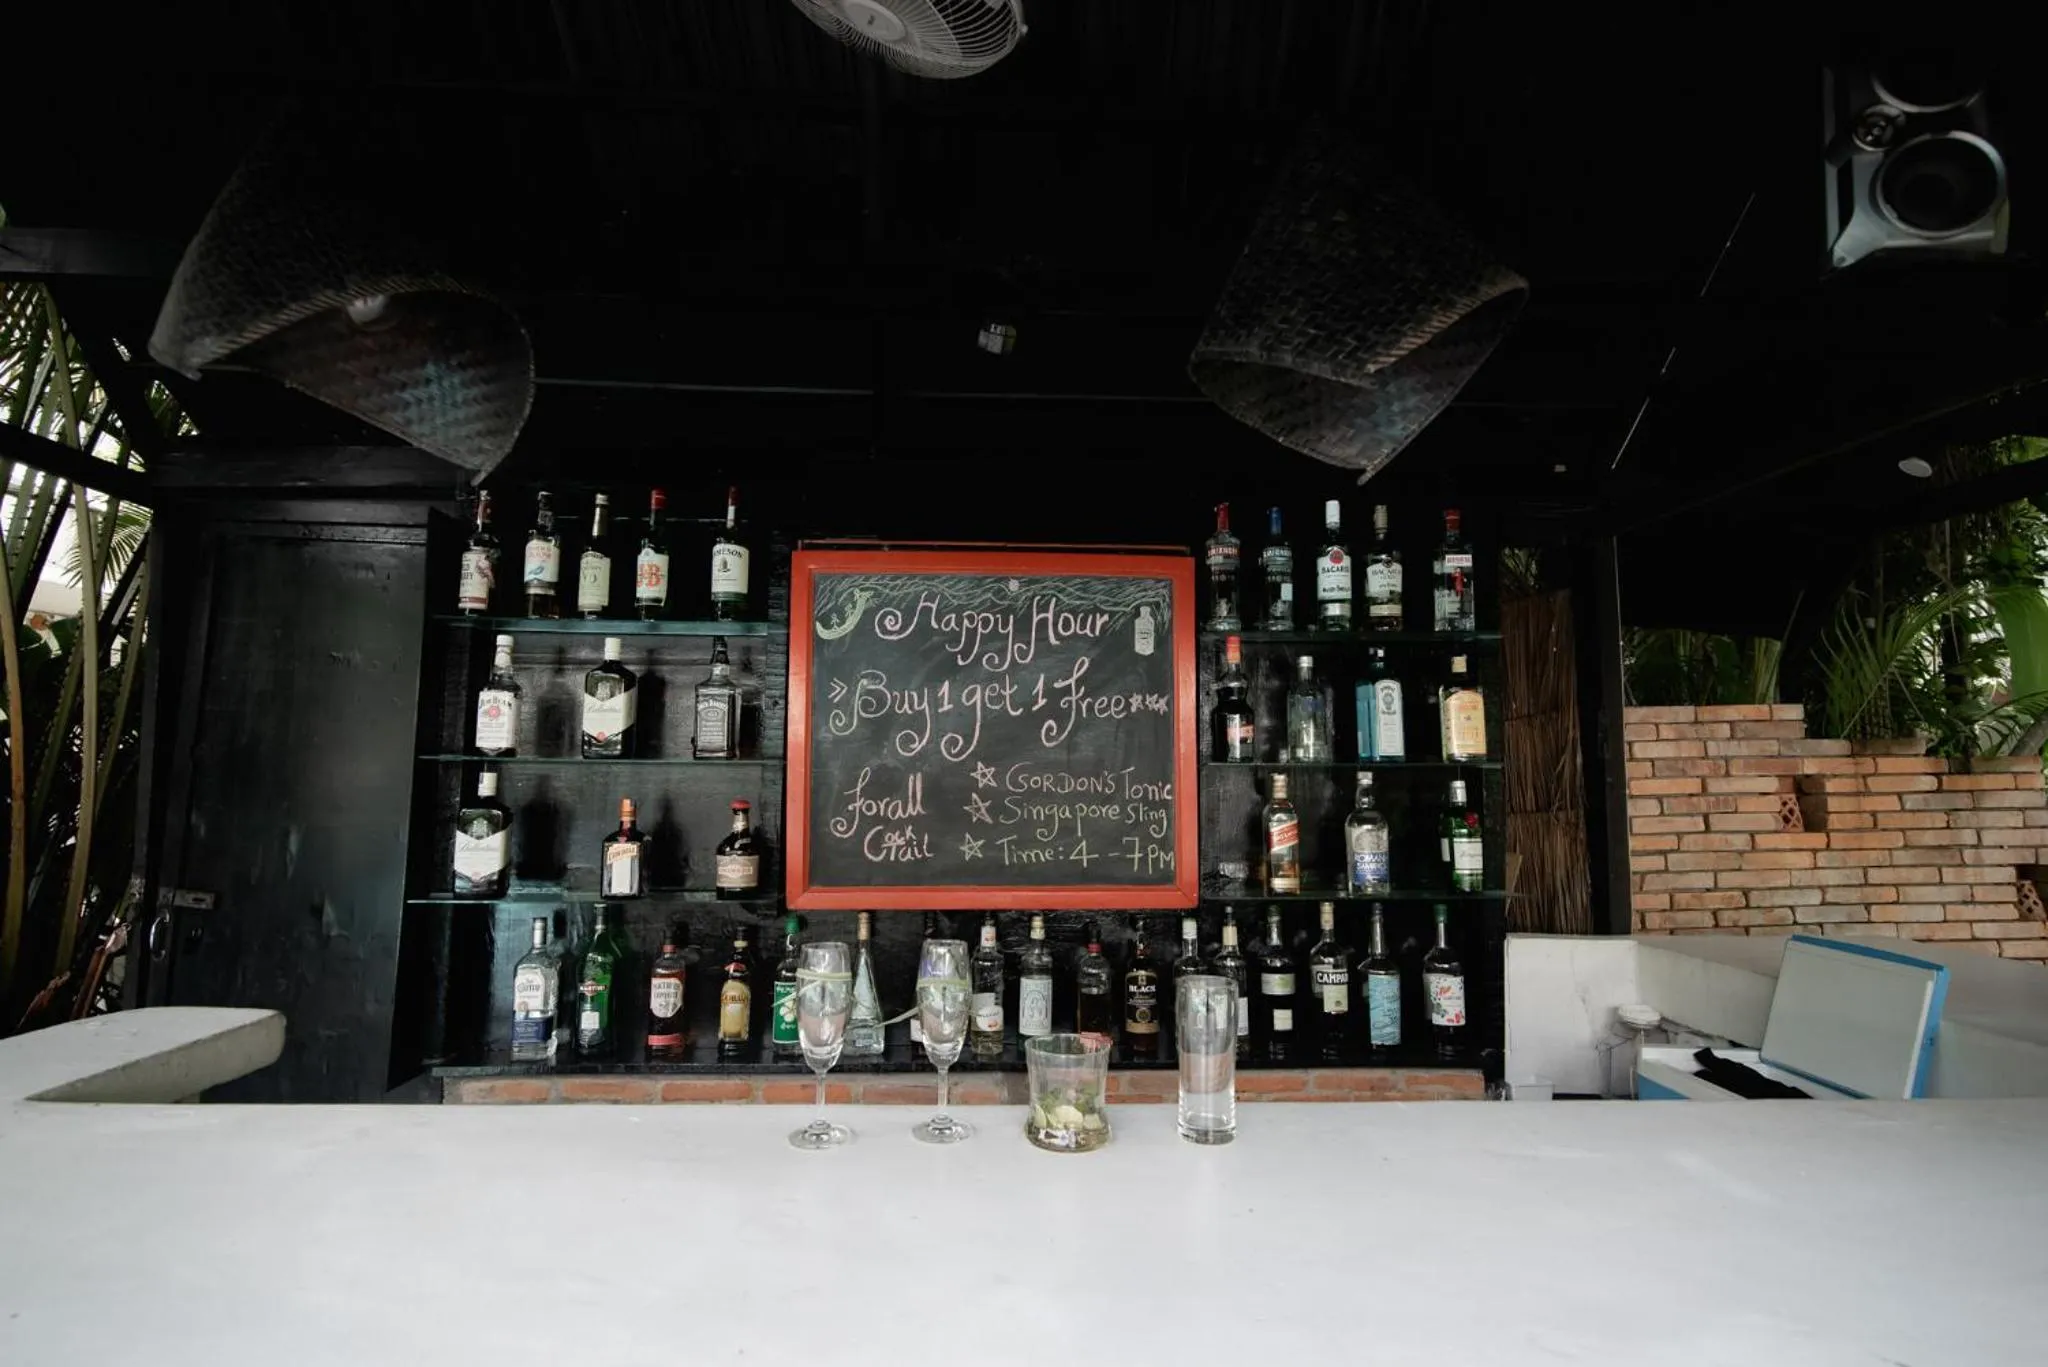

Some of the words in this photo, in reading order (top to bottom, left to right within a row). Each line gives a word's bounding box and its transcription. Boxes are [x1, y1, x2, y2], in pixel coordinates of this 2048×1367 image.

[875, 590, 1014, 671] Happy
[1014, 596, 1110, 664] Hour
[829, 669, 931, 757] Buy
[936, 679, 954, 713] 1
[1031, 673, 1046, 712] 1
[939, 673, 1023, 762] get
[1005, 762, 1115, 794] GORDON'S
[1120, 766, 1173, 802] Tonic
[998, 795, 1121, 842] Singapore
[1125, 803, 1168, 838] Sling
[994, 835, 1065, 866] Time:
[1068, 839, 1099, 868] 4
